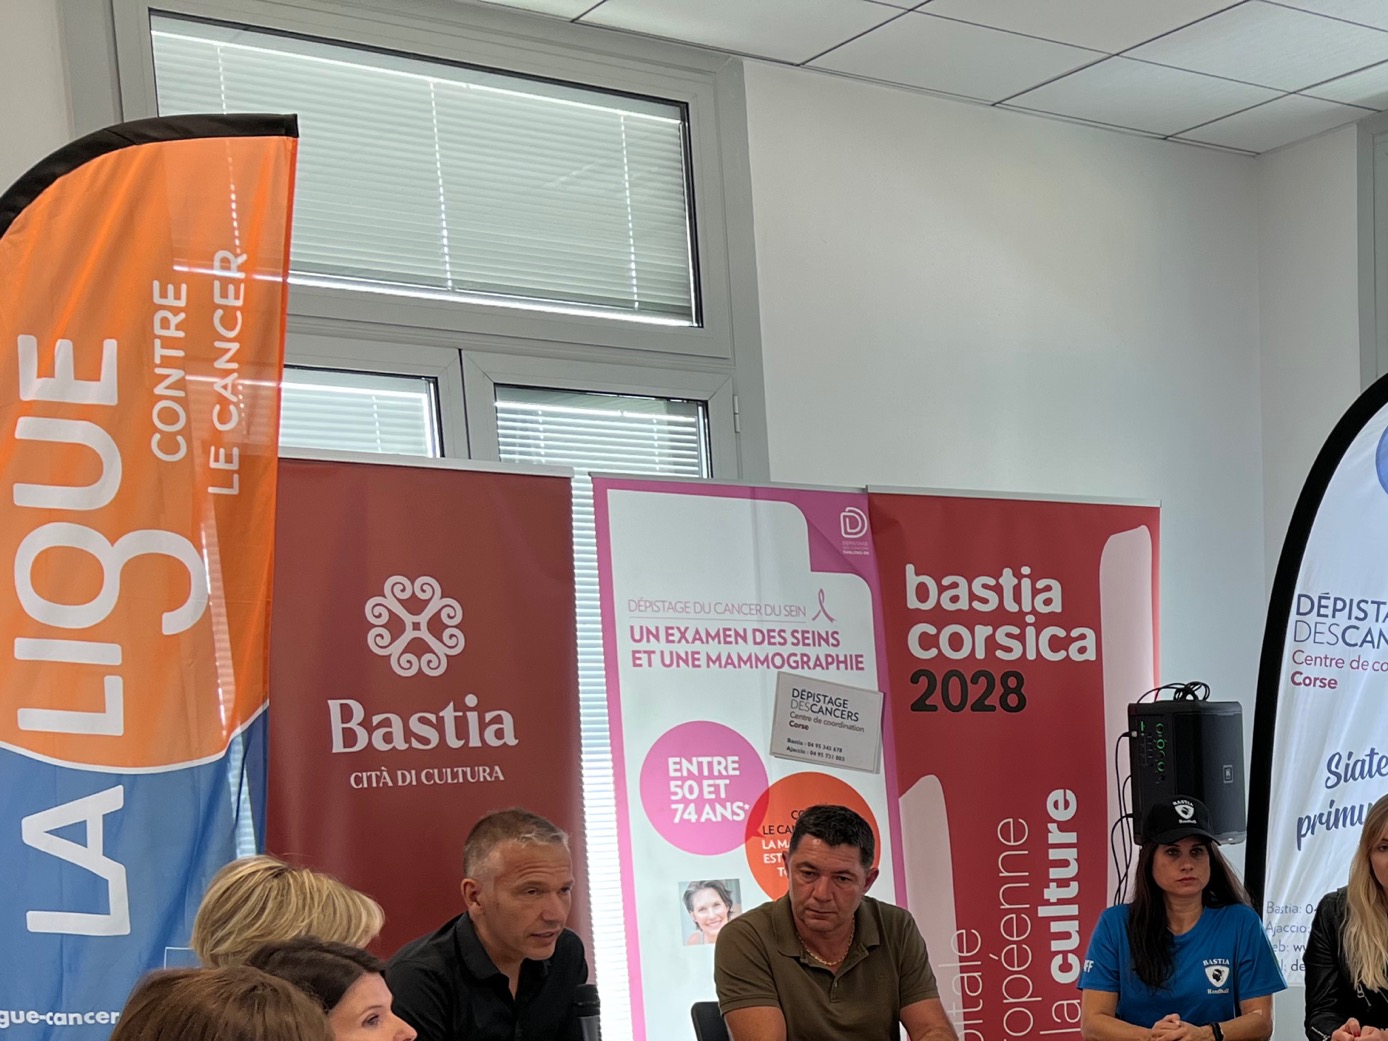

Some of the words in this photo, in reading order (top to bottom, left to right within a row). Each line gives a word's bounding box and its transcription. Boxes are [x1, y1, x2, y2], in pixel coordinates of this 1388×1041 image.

[212, 250, 247, 431] CANCER
[151, 280, 187, 461] CONTRE
[208, 446, 239, 494] LE
[905, 563, 1062, 613] bastia
[628, 597, 691, 614] DÉPISTAGE
[693, 602, 712, 615] DU
[714, 602, 763, 617] CANCER
[765, 604, 782, 617] DU
[783, 604, 806, 618] SEIN
[629, 625, 660, 644] UN
[665, 626, 747, 645] EXAMEN
[752, 628, 787, 647] DES
[790, 630, 840, 648] SEINS
[907, 614, 1097, 661] corsica
[631, 650, 655, 668] ET
[660, 650, 701, 669] UNE
[706, 652, 864, 671] MAMMOGRAPHIE
[1292, 650, 1345, 669] Centre
[1349, 655, 1369, 671] de
[910, 669, 1027, 713] 2028
[1290, 671, 1338, 690] Corse
[791, 688, 849, 709] DÉPISTAGE
[327, 693, 519, 753] Bastia
[788, 720, 809, 730] Corse
[789, 711, 812, 722] Centre
[813, 716, 822, 724] de
[823, 719, 865, 732] coordination
[350, 766, 393, 789] CITÀ
[397, 769, 417, 786] DI
[421, 765, 505, 785] CULTURA
[668, 756, 740, 777] ENTRE
[670, 780, 699, 800] 50
[703, 779, 730, 799] ET
[671, 803, 697, 824] 74
[762, 825, 775, 835] LE
[762, 839, 776, 850] LA
[21, 785, 130, 936] LA
[1037, 788, 1080, 985] culture
[1266, 901, 1301, 914] Bastia:
[1266, 921, 1310, 937] Ajaccio:
[1202, 958, 1230, 966] BASTIA
[1040, 999, 1081, 1034] la
